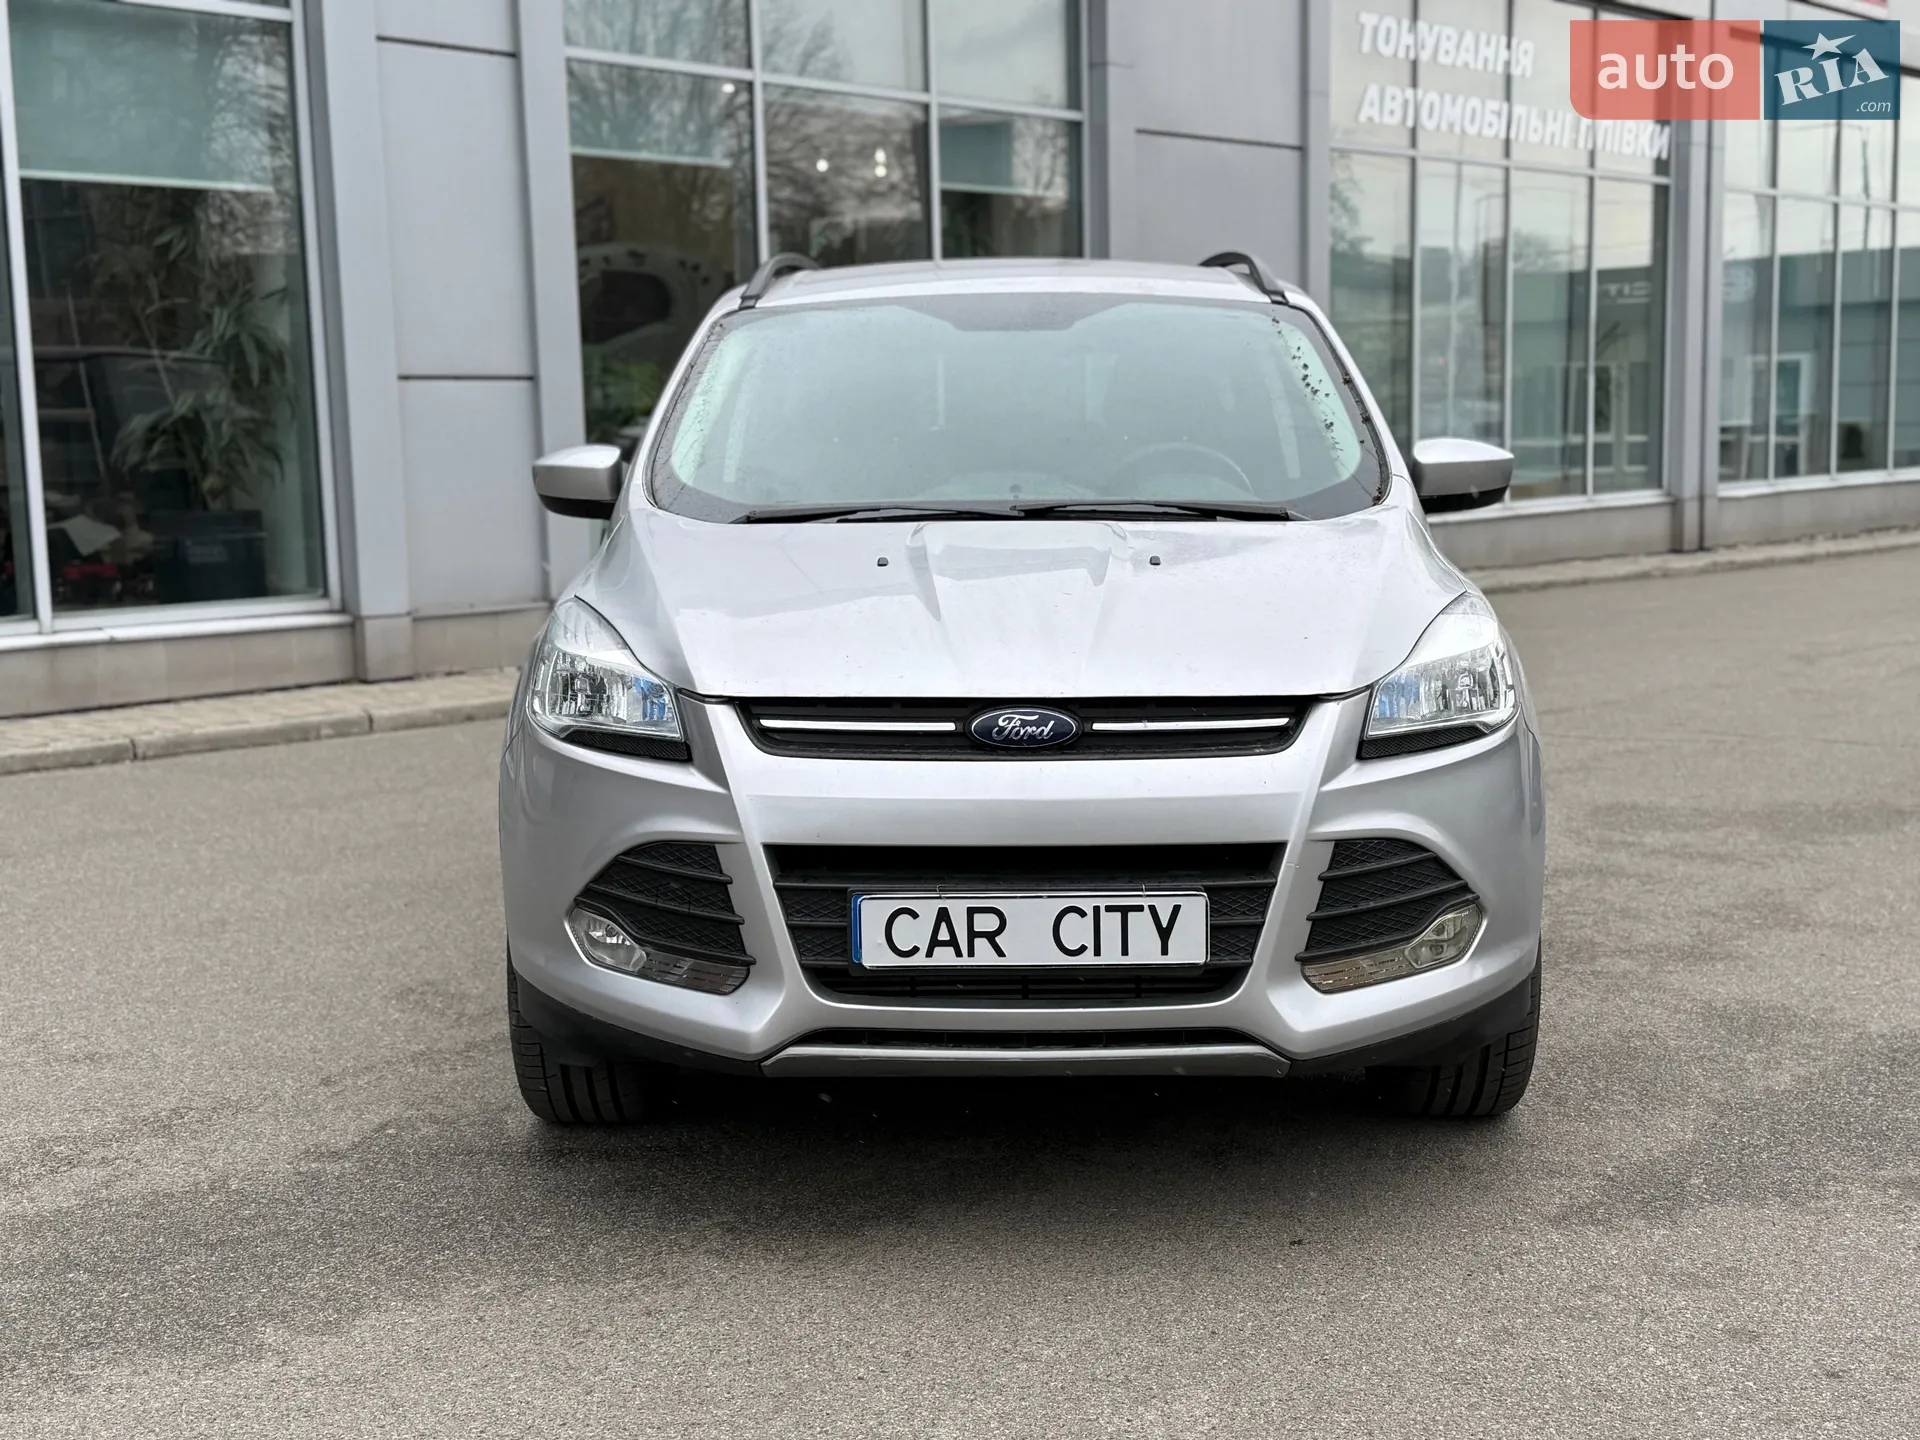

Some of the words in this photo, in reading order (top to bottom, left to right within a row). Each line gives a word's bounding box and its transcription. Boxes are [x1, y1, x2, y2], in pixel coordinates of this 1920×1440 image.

[1357, 11, 1536, 78] ТОНУВАННЯ
[1357, 83, 1572, 150] АВТОМОБІЛЬНІ
[1576, 115, 1671, 161] ПЛІВКИ
[991, 714, 1054, 740] Ford
[884, 906, 1007, 958] CAR
[1052, 904, 1182, 958] CITY
